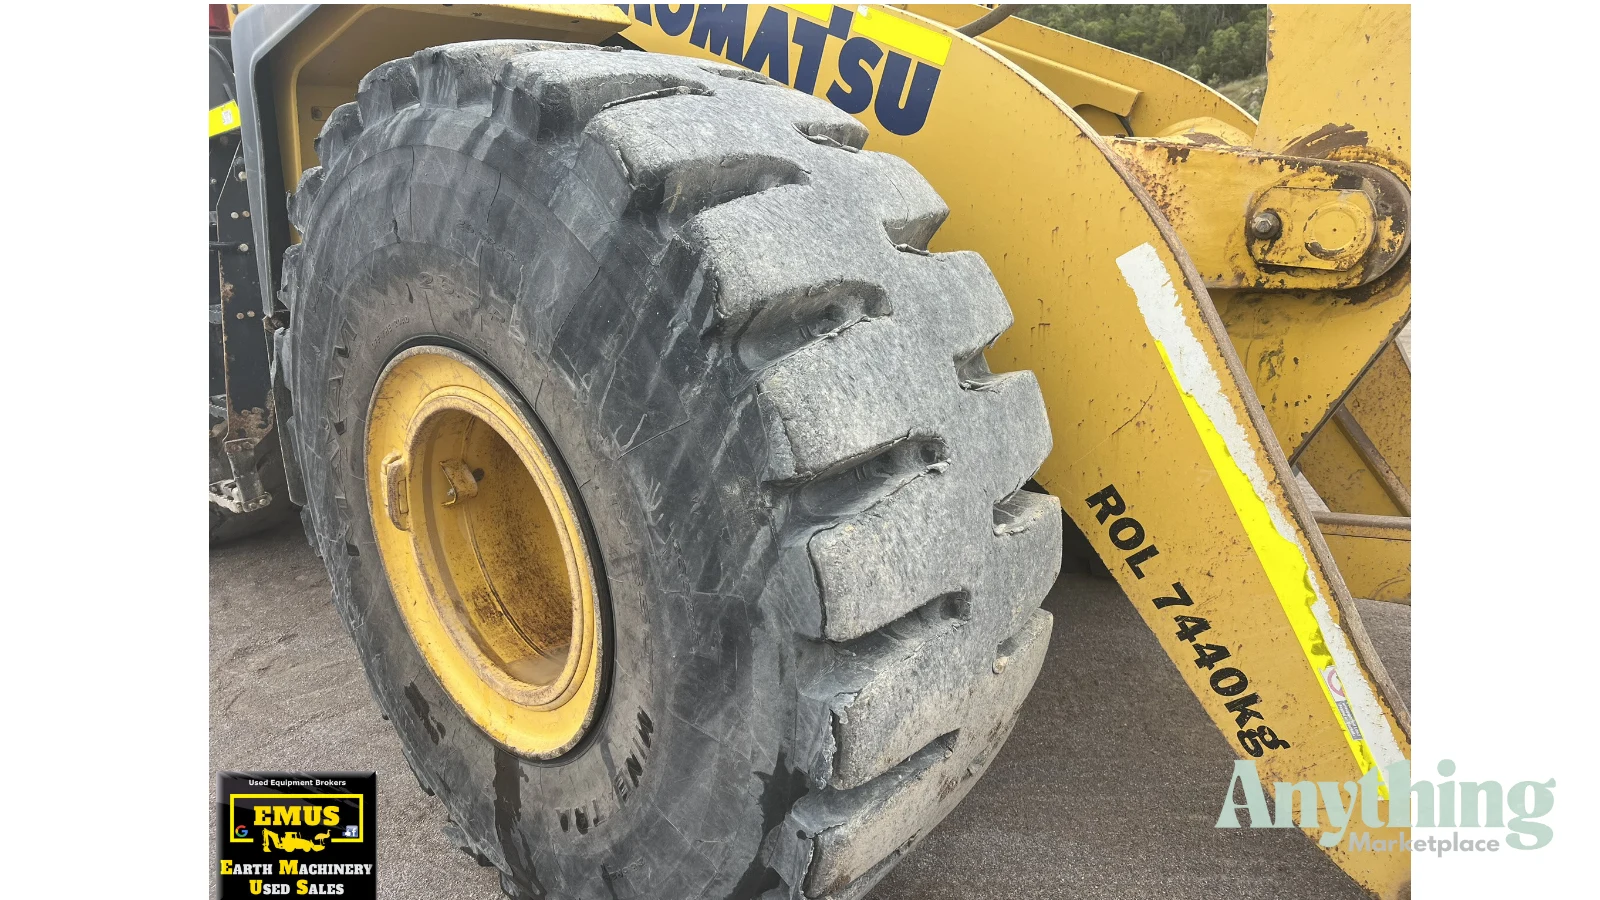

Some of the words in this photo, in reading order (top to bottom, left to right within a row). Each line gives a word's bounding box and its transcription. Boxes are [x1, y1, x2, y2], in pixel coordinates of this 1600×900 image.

[623, 4, 942, 136] MATSU
[1085, 484, 1160, 580] ROL
[1152, 582, 1291, 758] 7440kg
